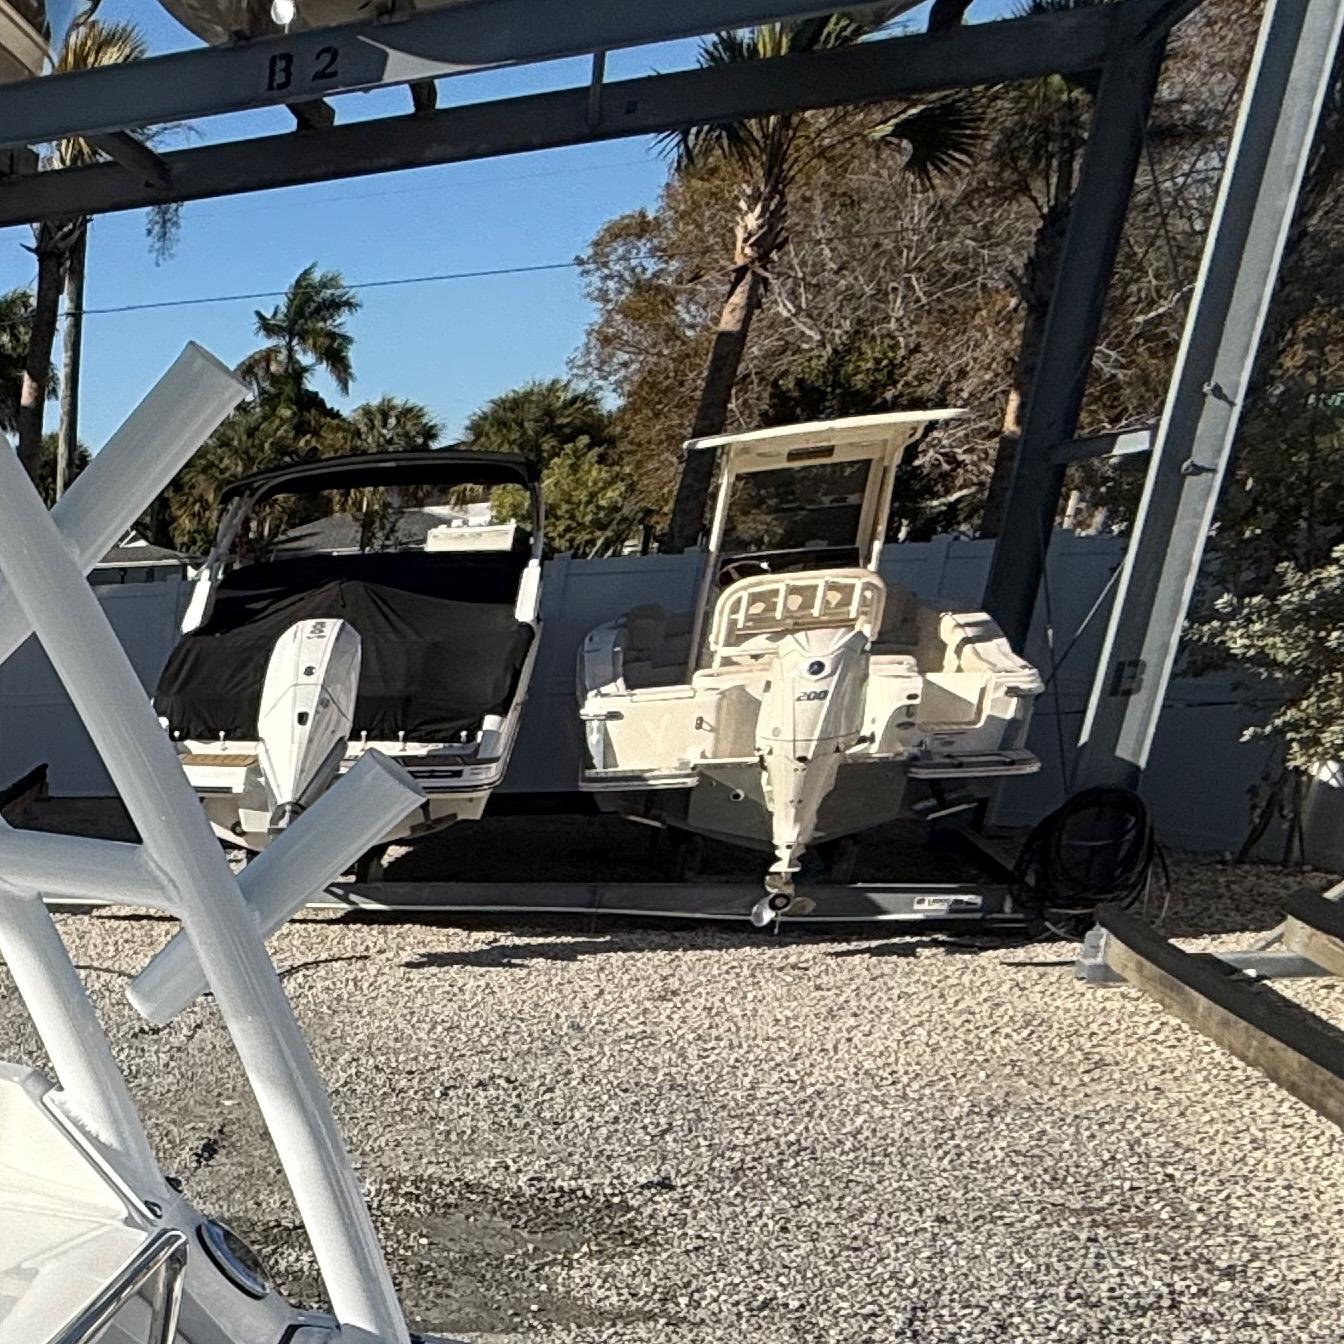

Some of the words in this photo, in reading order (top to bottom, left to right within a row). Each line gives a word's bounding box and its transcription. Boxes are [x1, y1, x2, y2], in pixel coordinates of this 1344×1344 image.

[266, 52, 294, 91] B
[311, 46, 339, 82] 2
[795, 690, 830, 702] 200
[1109, 659, 1148, 697] B
